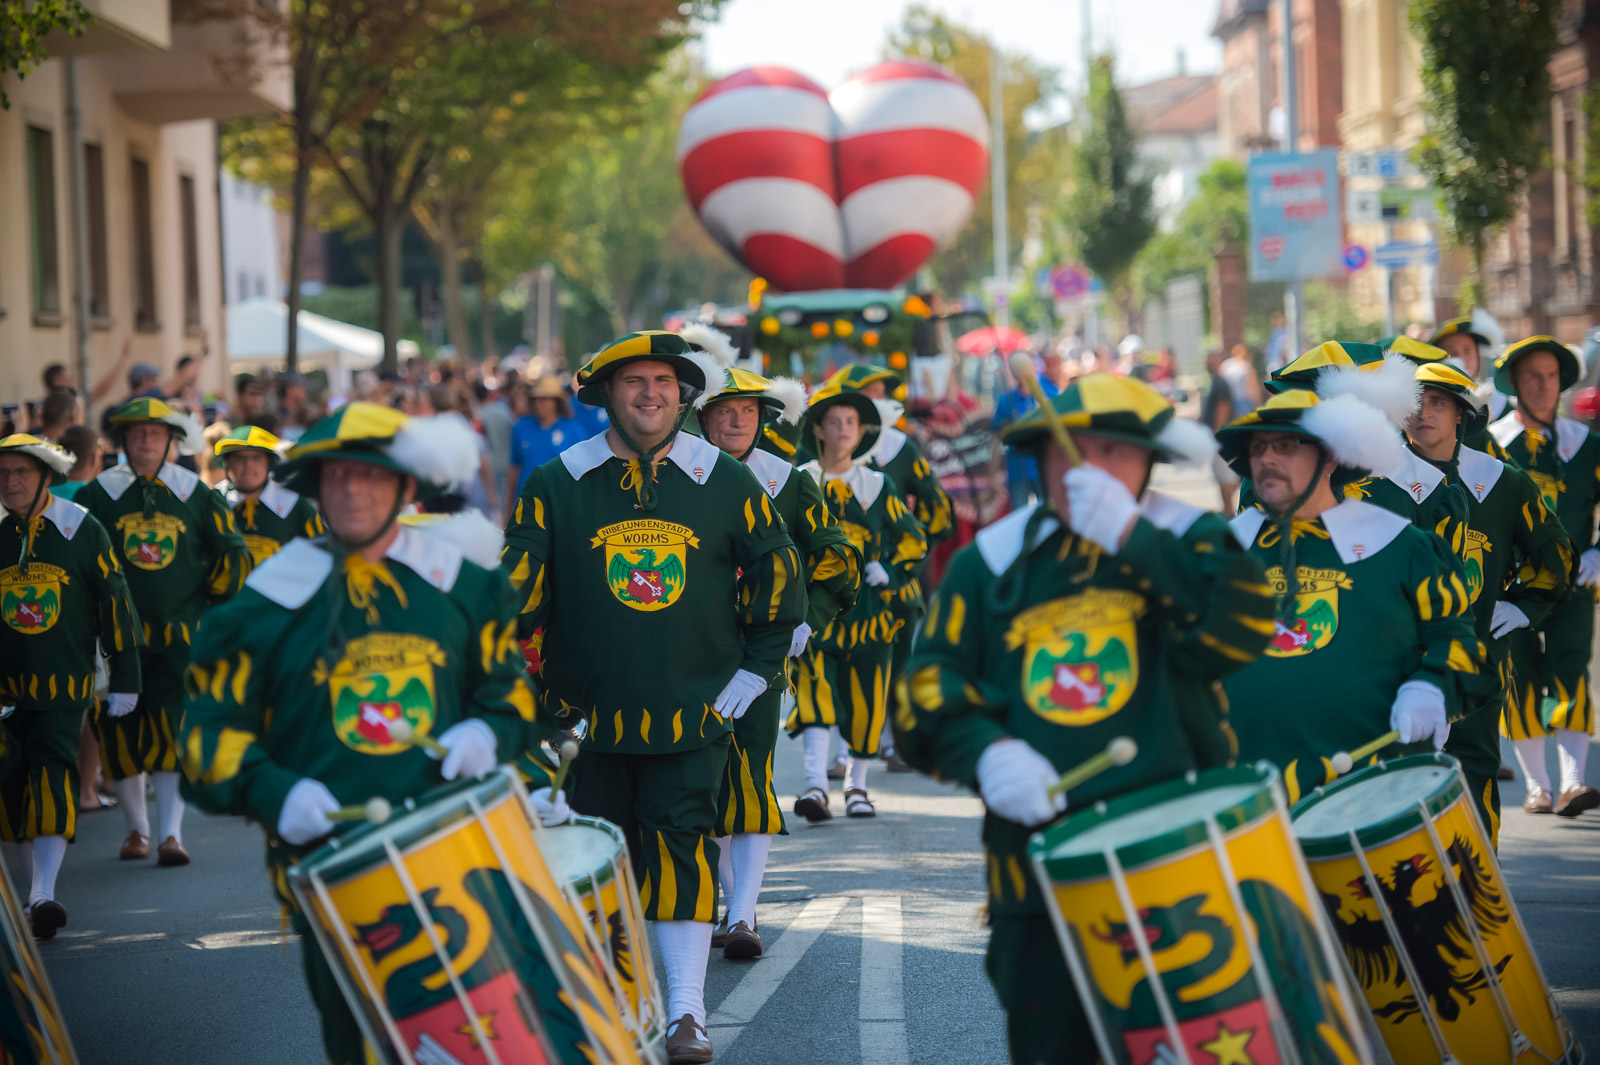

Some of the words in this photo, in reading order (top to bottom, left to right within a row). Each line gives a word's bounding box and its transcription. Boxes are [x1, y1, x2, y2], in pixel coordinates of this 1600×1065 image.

[602, 521, 690, 537] NIBELUNGENSTADT
[622, 533, 669, 544] WORMS
[11, 574, 47, 582] WORMS
